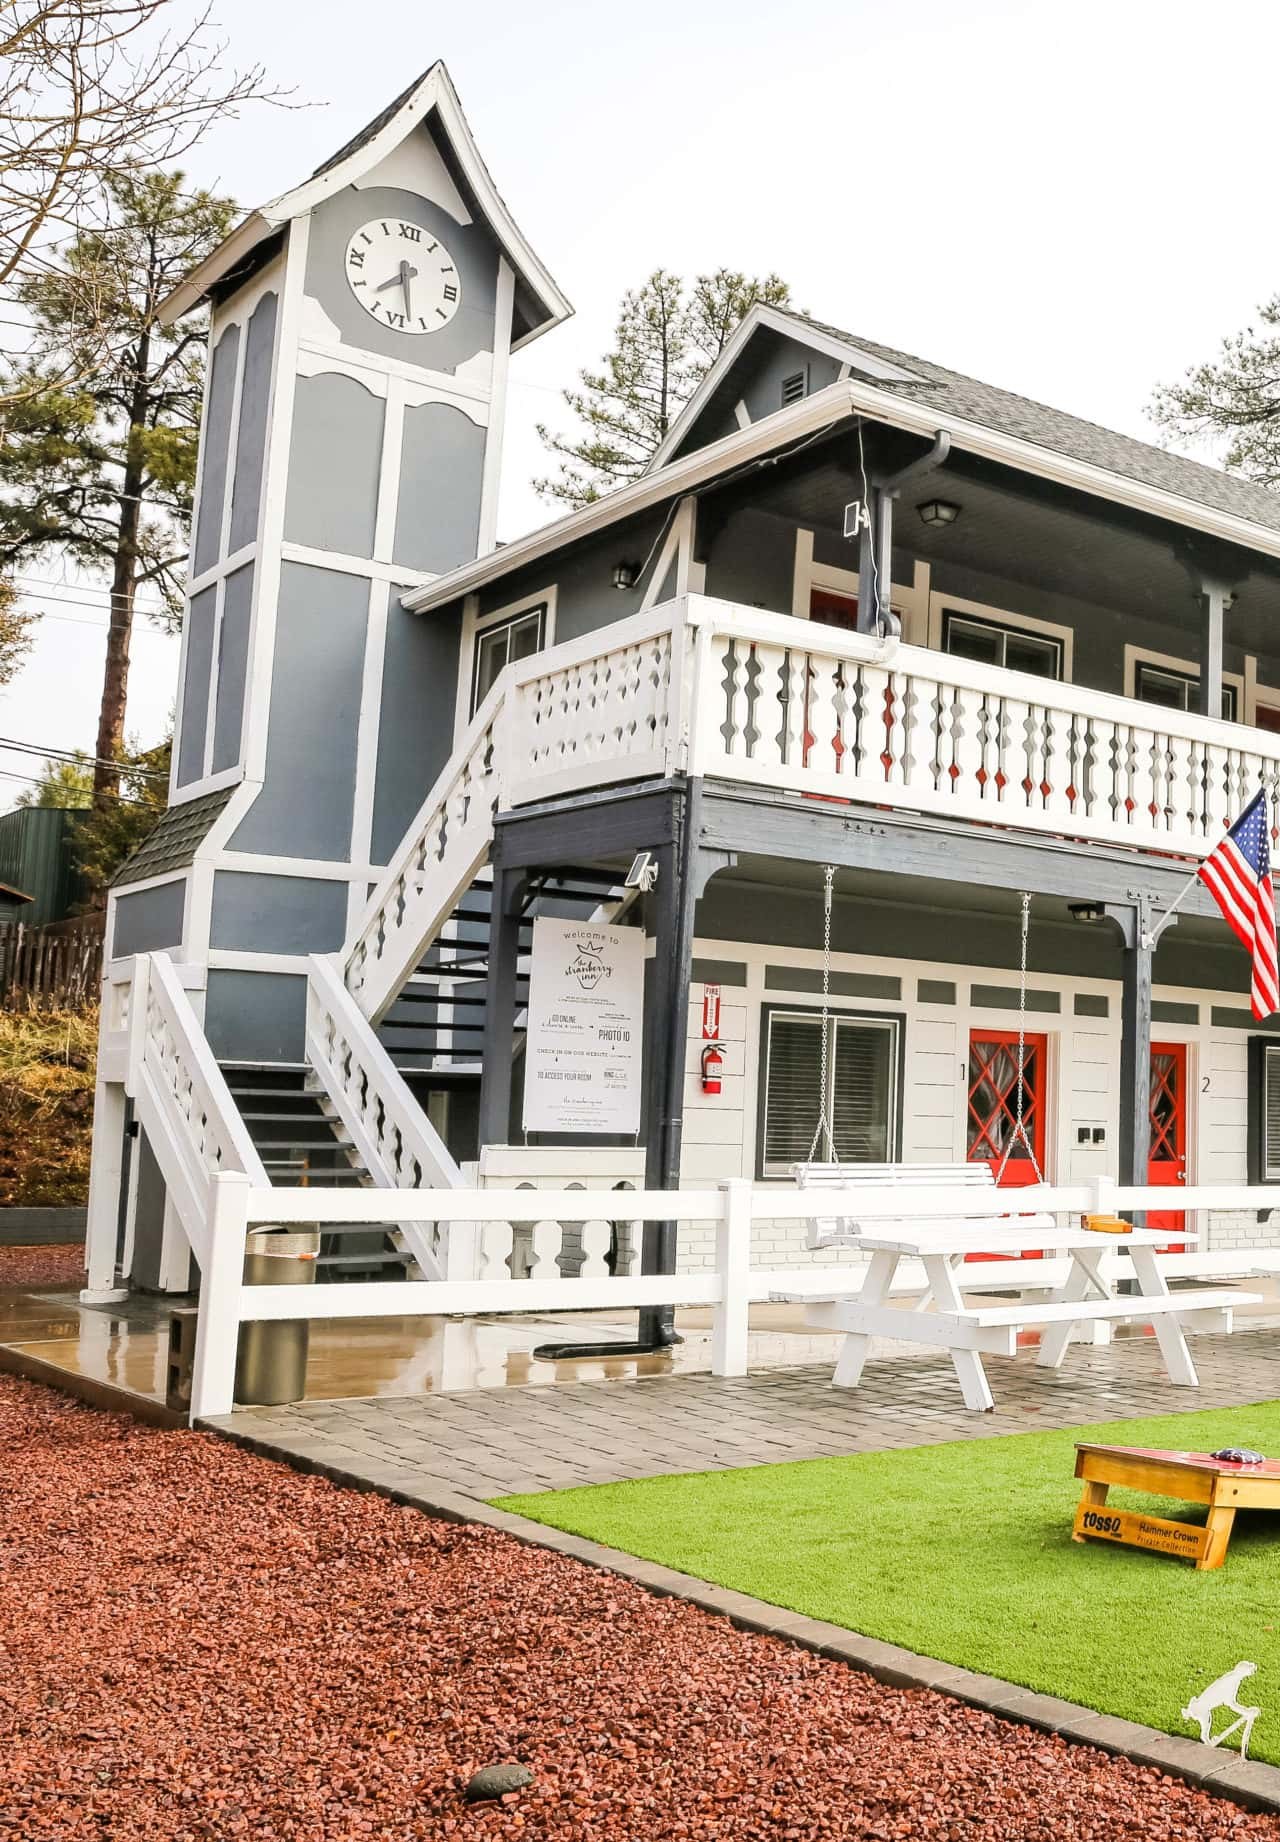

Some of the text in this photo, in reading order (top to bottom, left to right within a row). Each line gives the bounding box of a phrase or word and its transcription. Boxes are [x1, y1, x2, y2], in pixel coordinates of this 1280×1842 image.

[398, 223, 422, 242] XII
[350, 248, 365, 269] IX
[443, 284, 457, 303] III
[386, 311, 405, 328] VI
[563, 931, 619, 945] welcome to
[705, 987, 719, 996] FIRE
[560, 1015, 576, 1024] ONLINE
[599, 1030, 630, 1041] PHOTO ID
[1202, 1076, 1210, 1092] 2
[1139, 1522, 1199, 1545] Hammer Crown
[1136, 1535, 1160, 1547] Private
[1161, 1540, 1196, 1553] Collection
